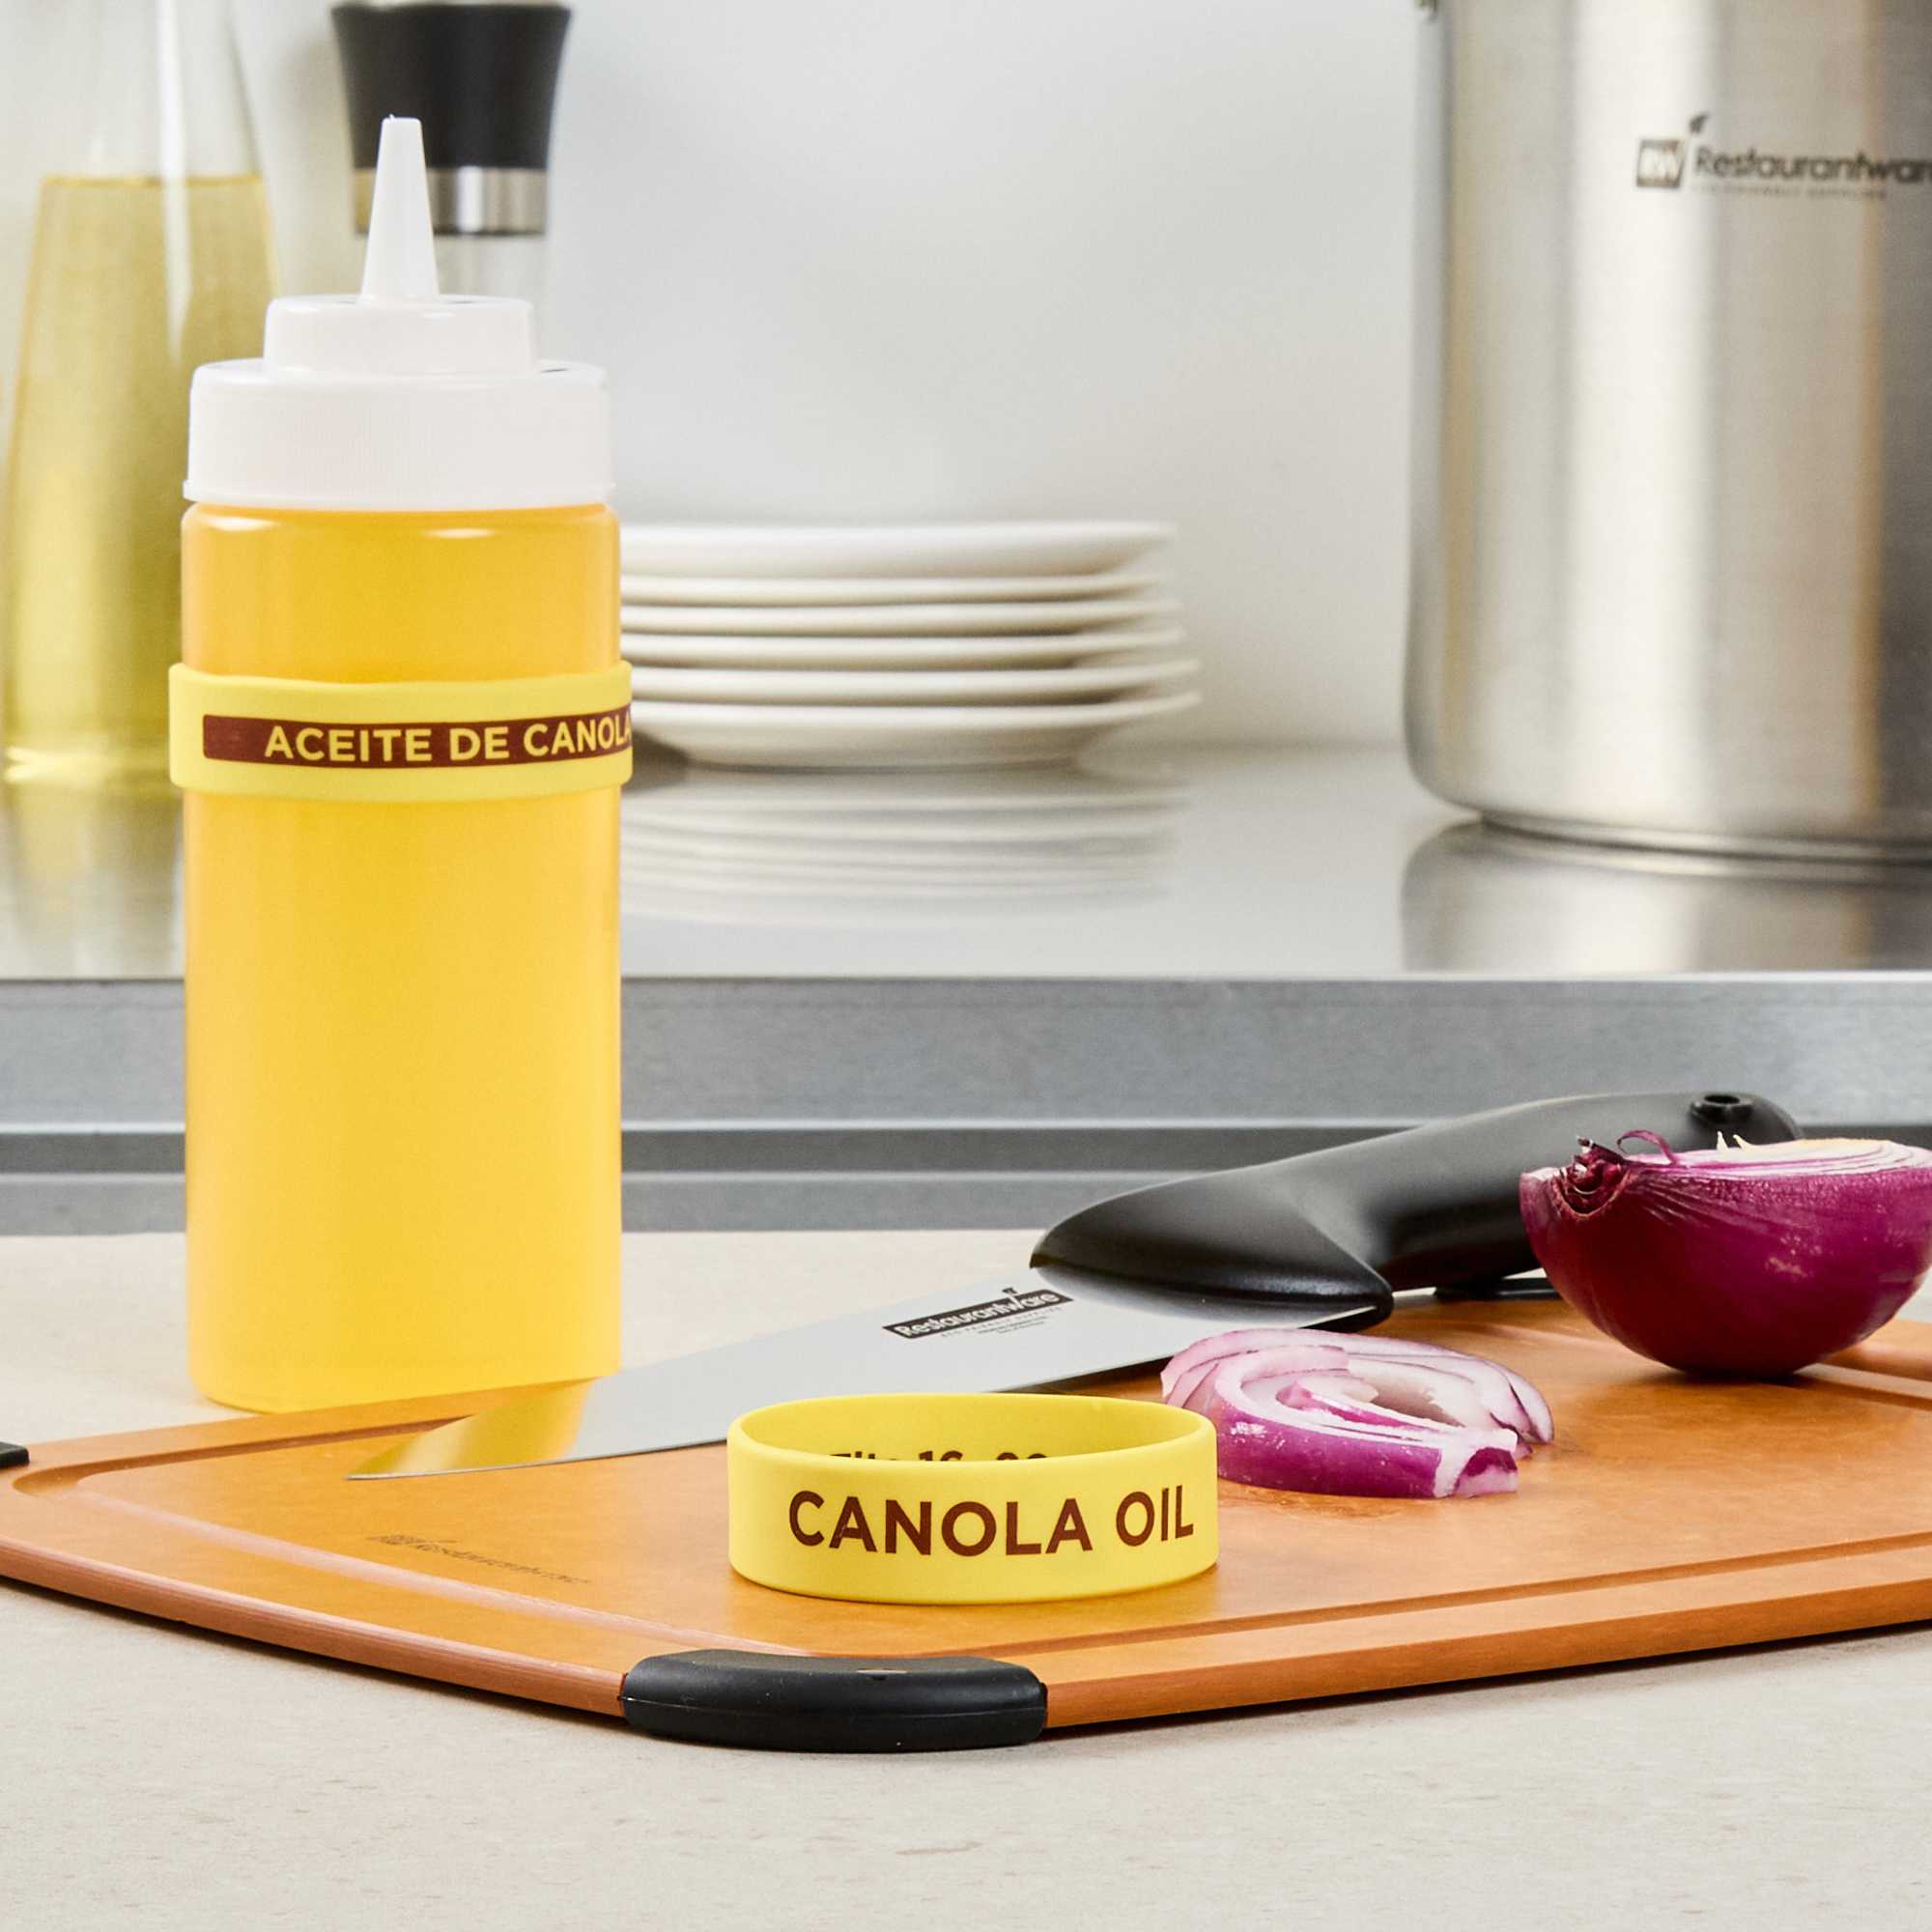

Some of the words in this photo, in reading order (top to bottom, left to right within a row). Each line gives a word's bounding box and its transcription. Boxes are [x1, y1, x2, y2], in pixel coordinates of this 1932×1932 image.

[265, 724, 432, 762] ACEITE
[449, 726, 509, 760] DE
[788, 1491, 1093, 1557] CANOLA
[1115, 1485, 1194, 1547] OIL
